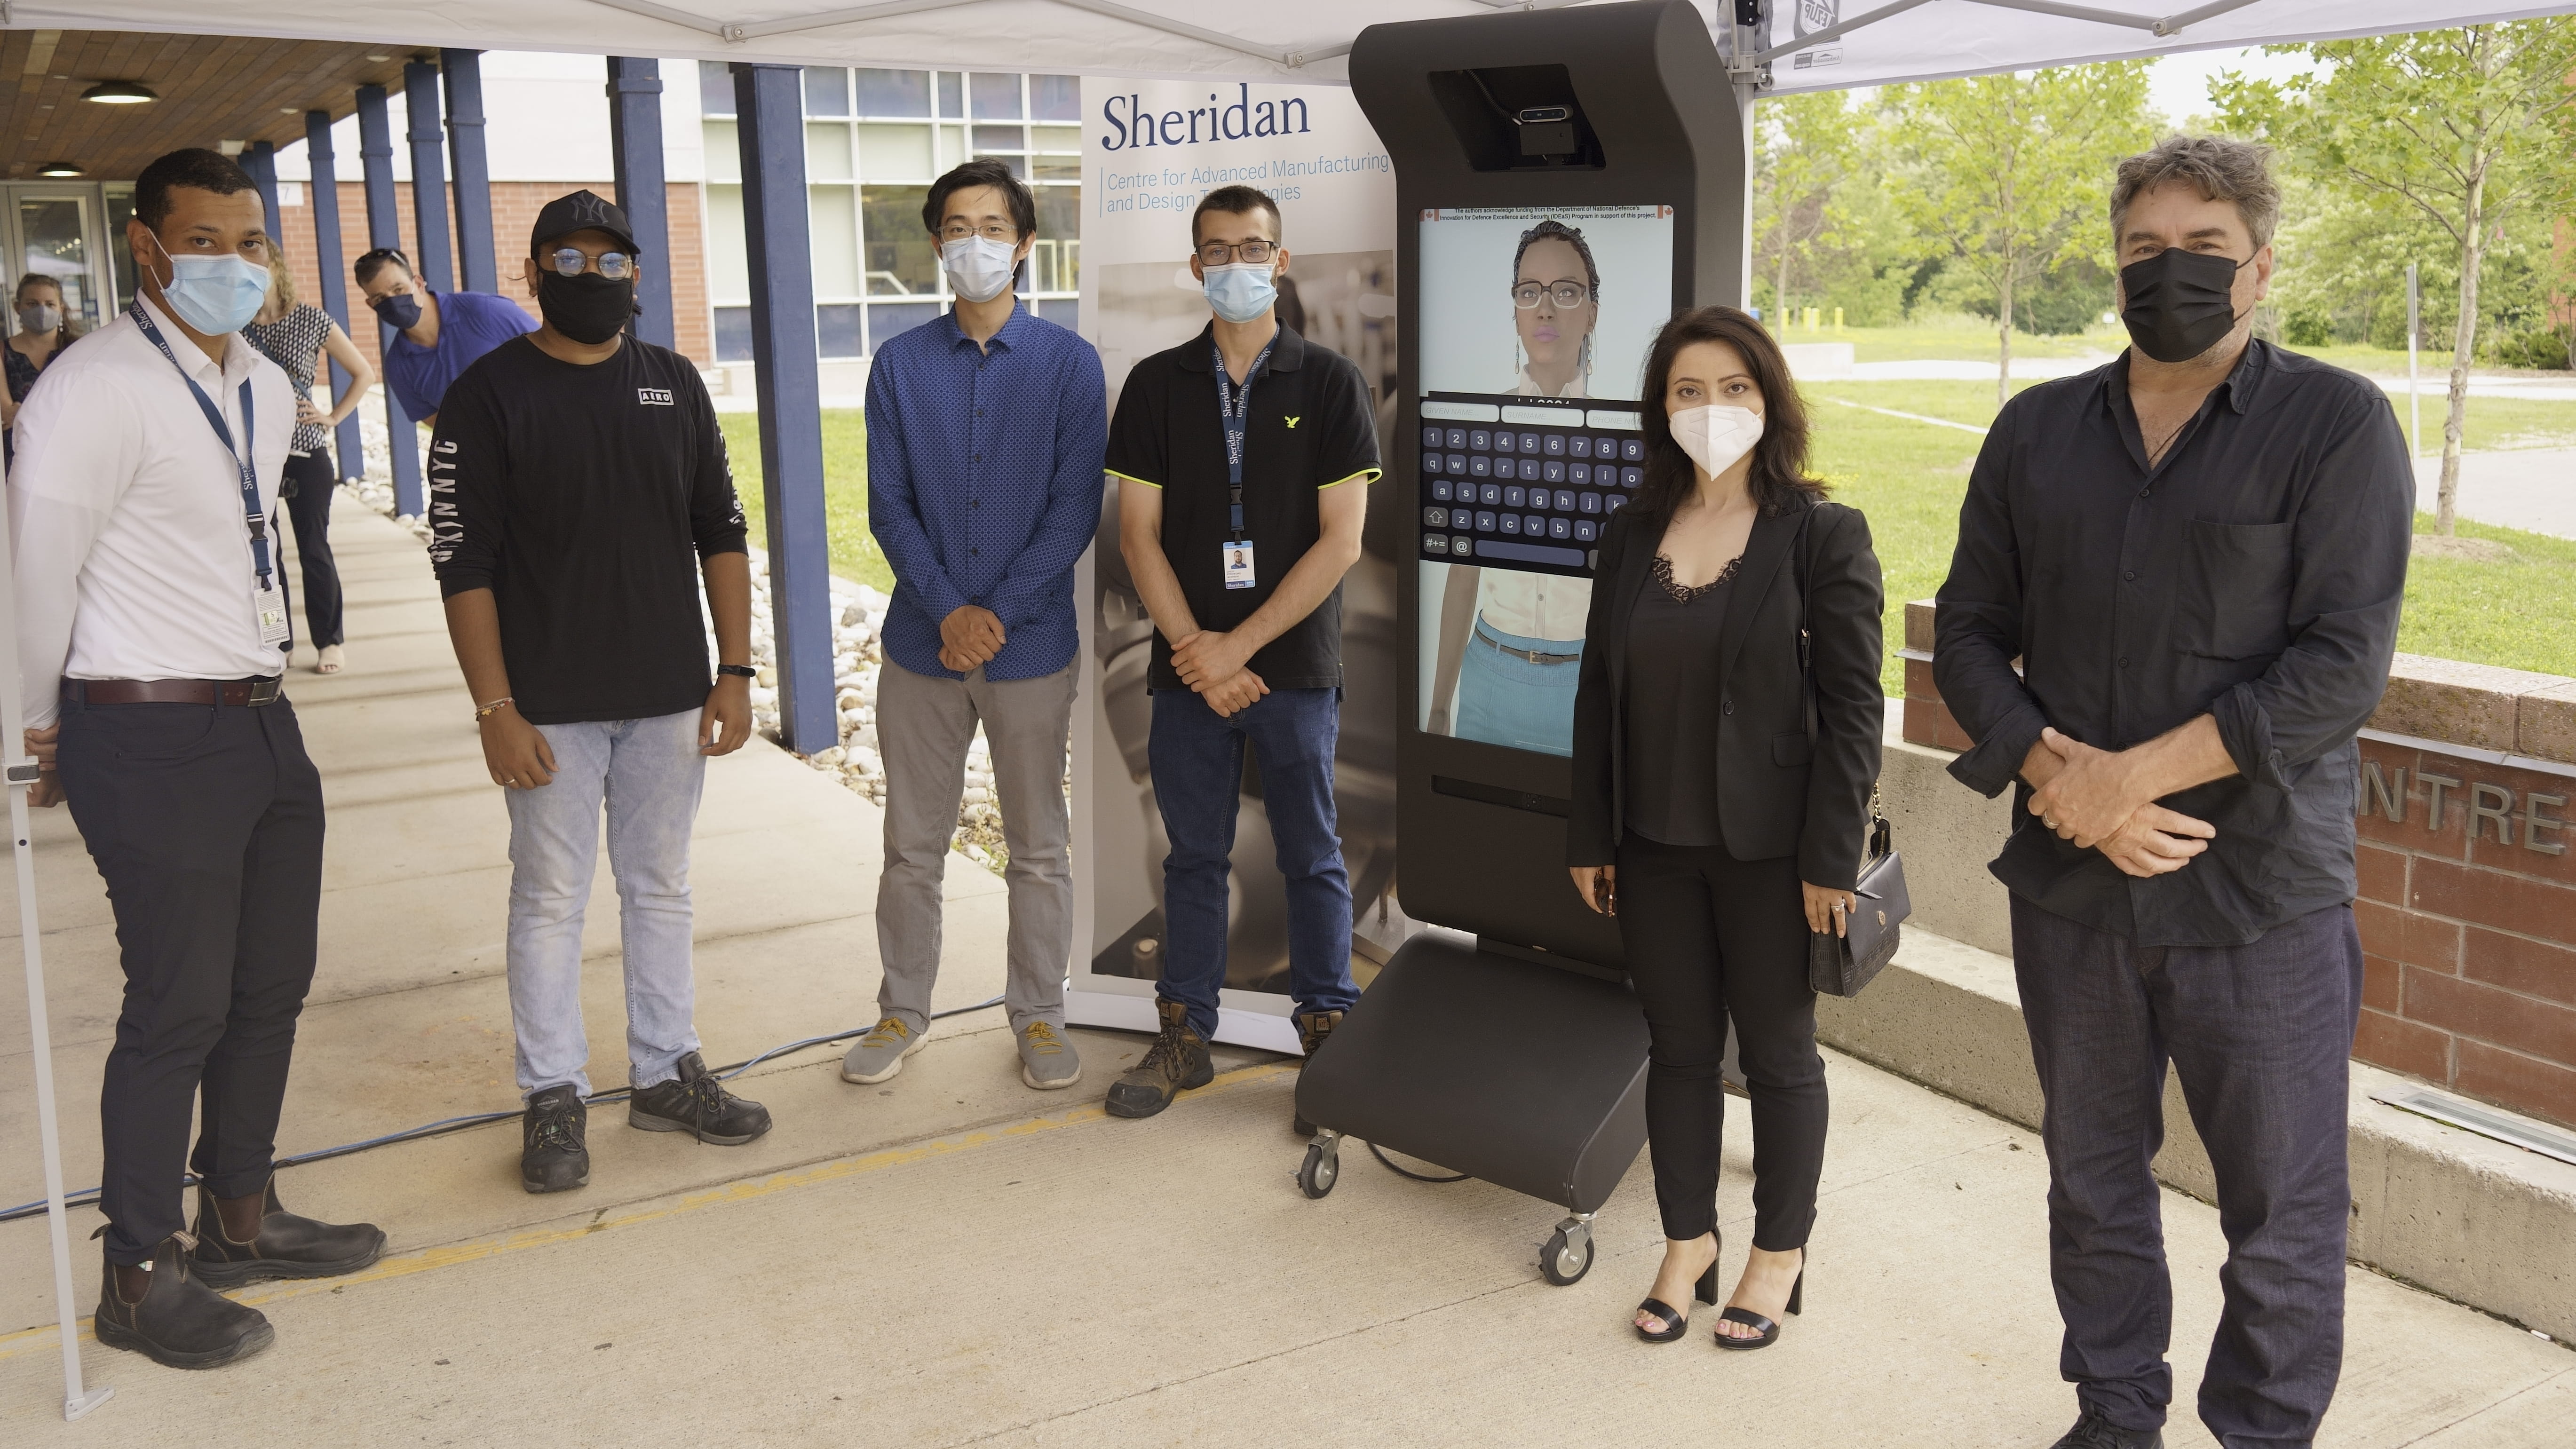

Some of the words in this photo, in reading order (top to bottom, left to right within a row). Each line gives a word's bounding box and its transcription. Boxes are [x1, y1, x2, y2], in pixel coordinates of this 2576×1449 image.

[1102, 83, 1311, 151] Sheridan
[1108, 172, 1157, 190] Centre
[1163, 169, 1186, 185] for
[1191, 161, 1266, 184] Advanced
[1273, 152, 1388, 177] Manufacturing
[571, 192, 609, 223] NY
[1108, 194, 1133, 212] and
[1140, 191, 1195, 212] Design
[1214, 347, 1225, 372] Sheridan
[1249, 348, 1271, 373] Sheridan
[643, 392, 669, 402] AERO
[1221, 382, 1231, 417] Sheridan
[1237, 384, 1249, 418] Sheridan
[1592, 416, 1622, 424] PHONE
[1227, 430, 1238, 464] Sheridan
[1430, 433, 1435, 442] 1
[1453, 434, 1459, 443] 2
[1477, 435, 1483, 445] 3
[1501, 437, 1508, 446] 4
[1526, 439, 1533, 448] 5
[1551, 440, 1558, 450] 6
[1577, 442, 1584, 451] 7
[1602, 443, 1609, 453] 8
[1629, 445, 1636, 455] 9
[1429, 460, 1435, 469] q
[1527, 465, 1531, 474] t
[1551, 469, 1558, 478] y
[1604, 470, 1607, 480] i
[1487, 490, 1493, 499] d
[1513, 491, 1517, 501] f
[1536, 496, 1543, 505] g
[1561, 496, 1568, 505] h
[1587, 498, 1591, 510] j
[1556, 523, 1563, 533] b
[1456, 541, 1467, 553] @
[2360, 762, 2567, 855] NTRE
